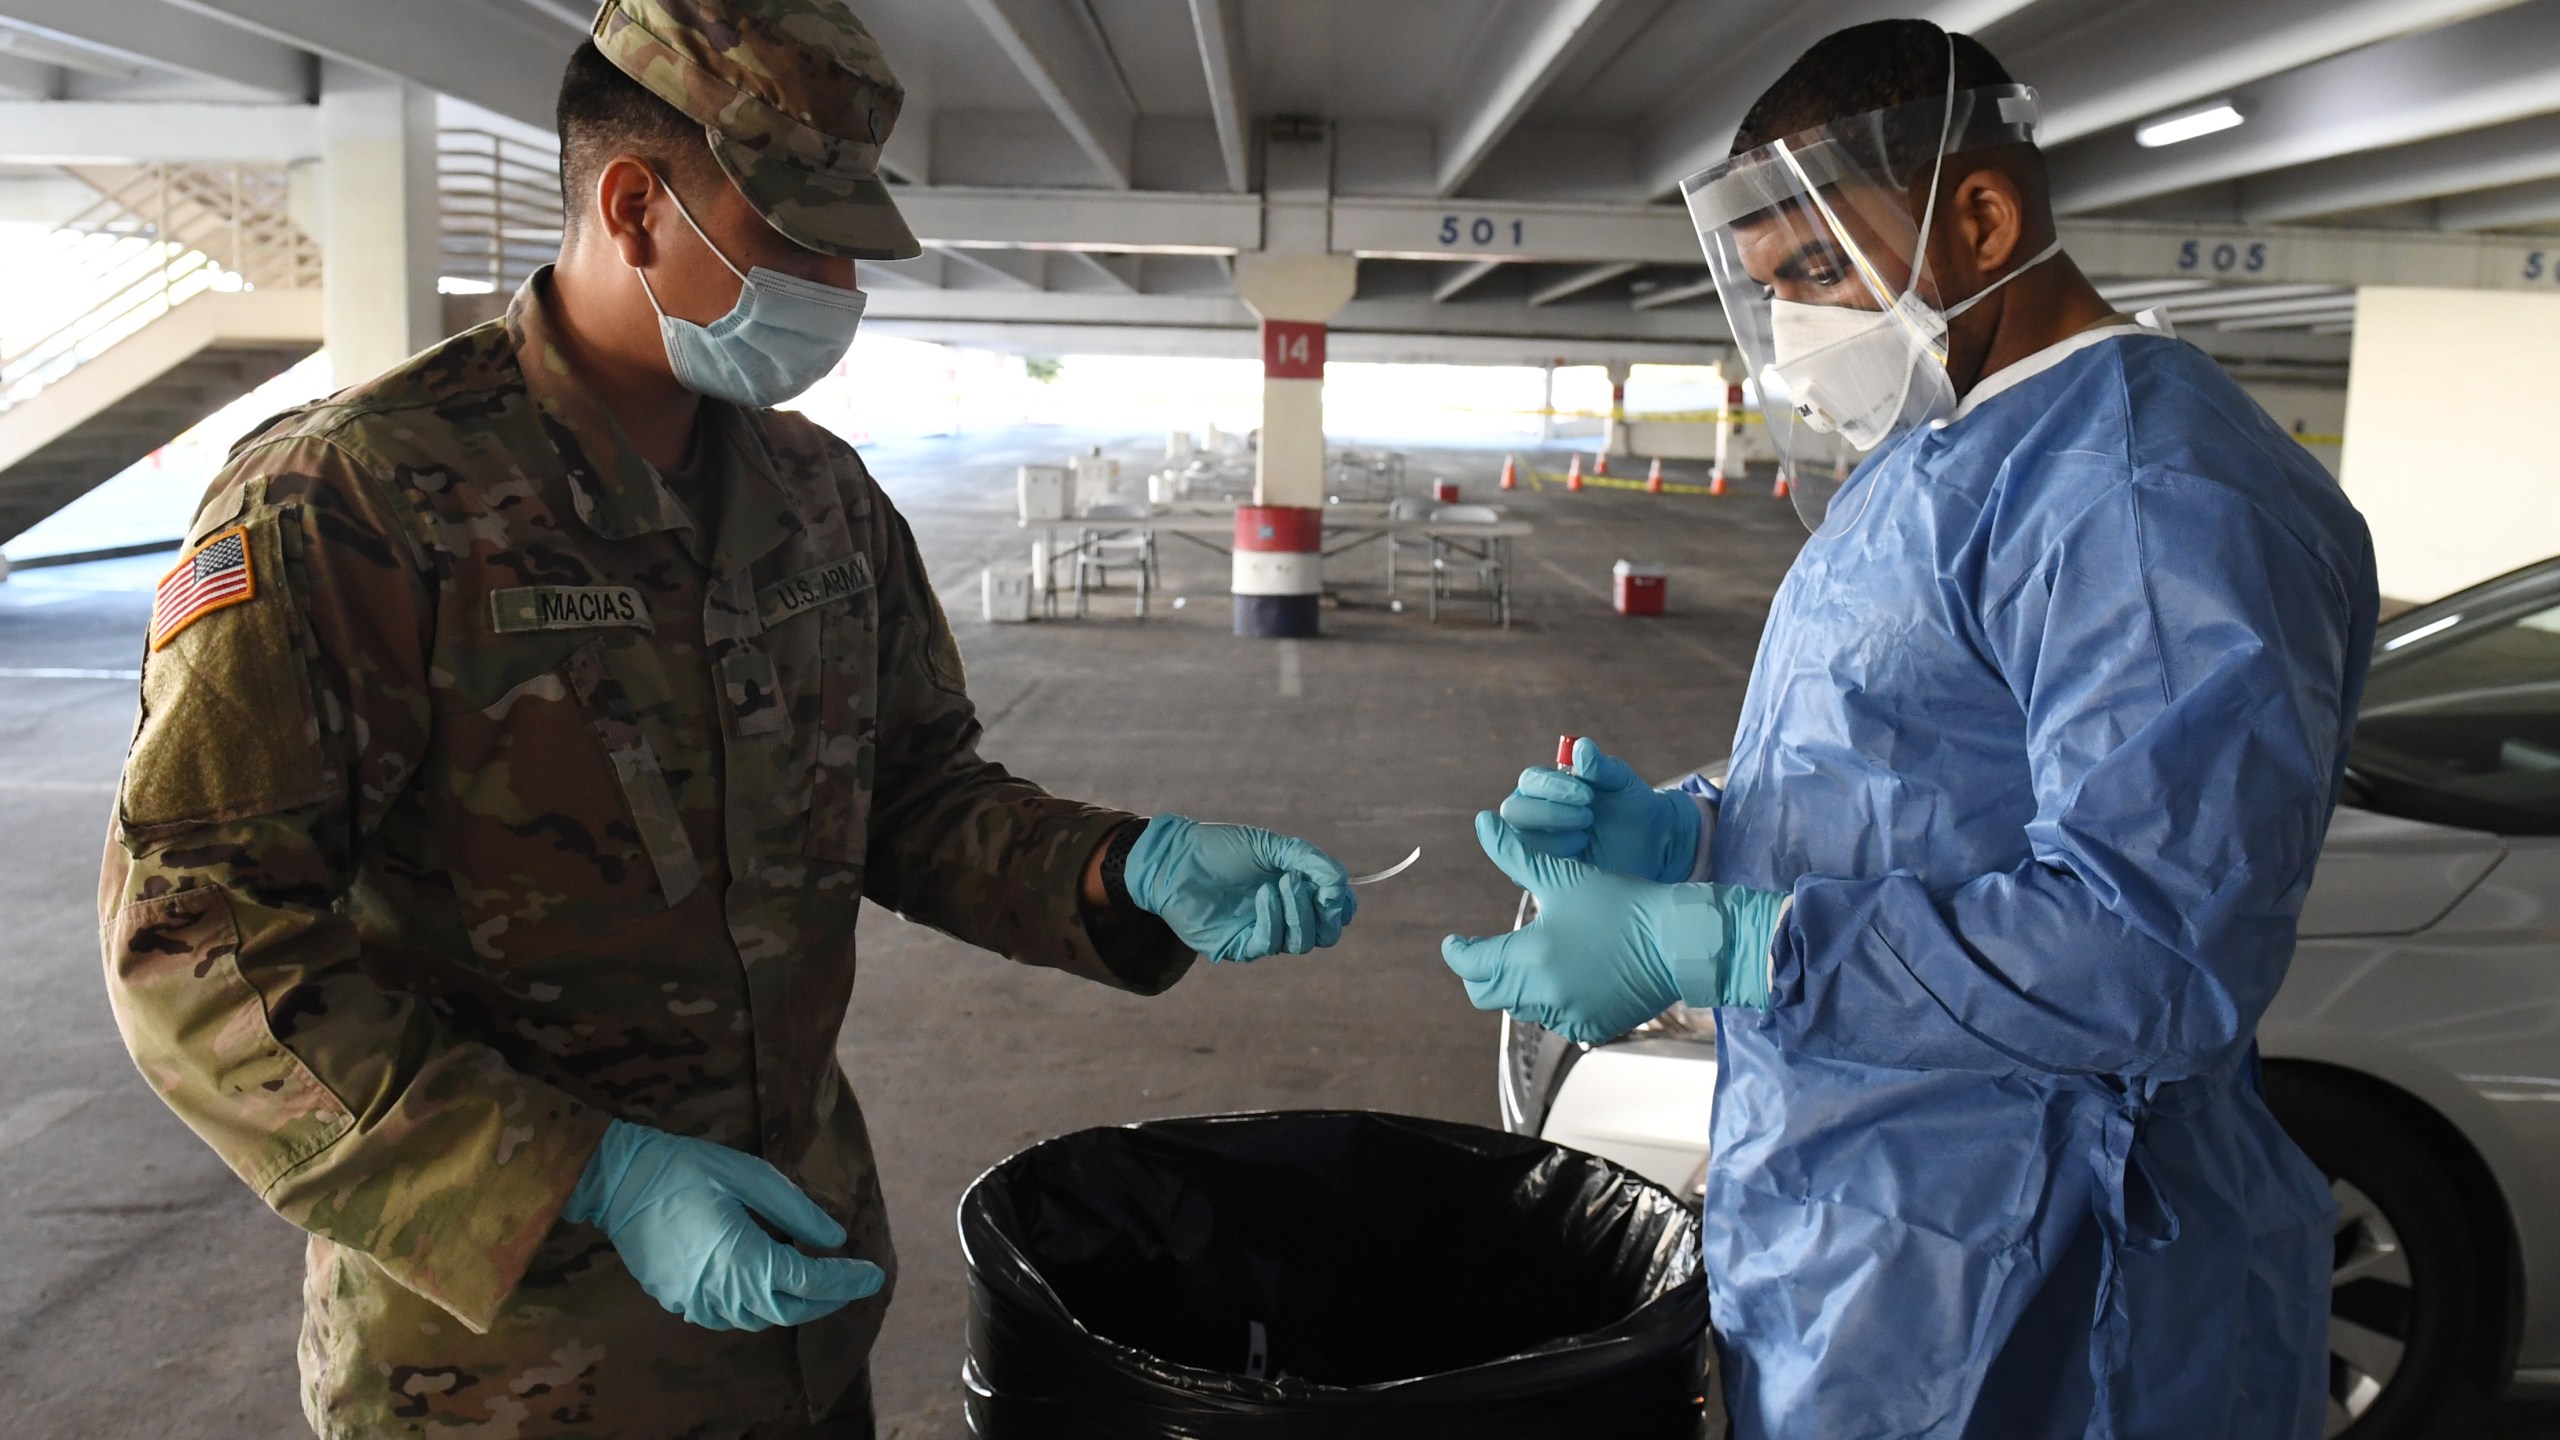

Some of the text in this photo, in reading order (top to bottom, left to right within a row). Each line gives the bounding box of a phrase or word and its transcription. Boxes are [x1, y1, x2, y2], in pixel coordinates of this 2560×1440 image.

[1439, 216, 1522, 246] 501
[2178, 240, 2266, 273] 505
[1278, 333, 1310, 365] 14
[777, 559, 865, 610] U.S. ARMY
[540, 592, 635, 621] MACIAS
